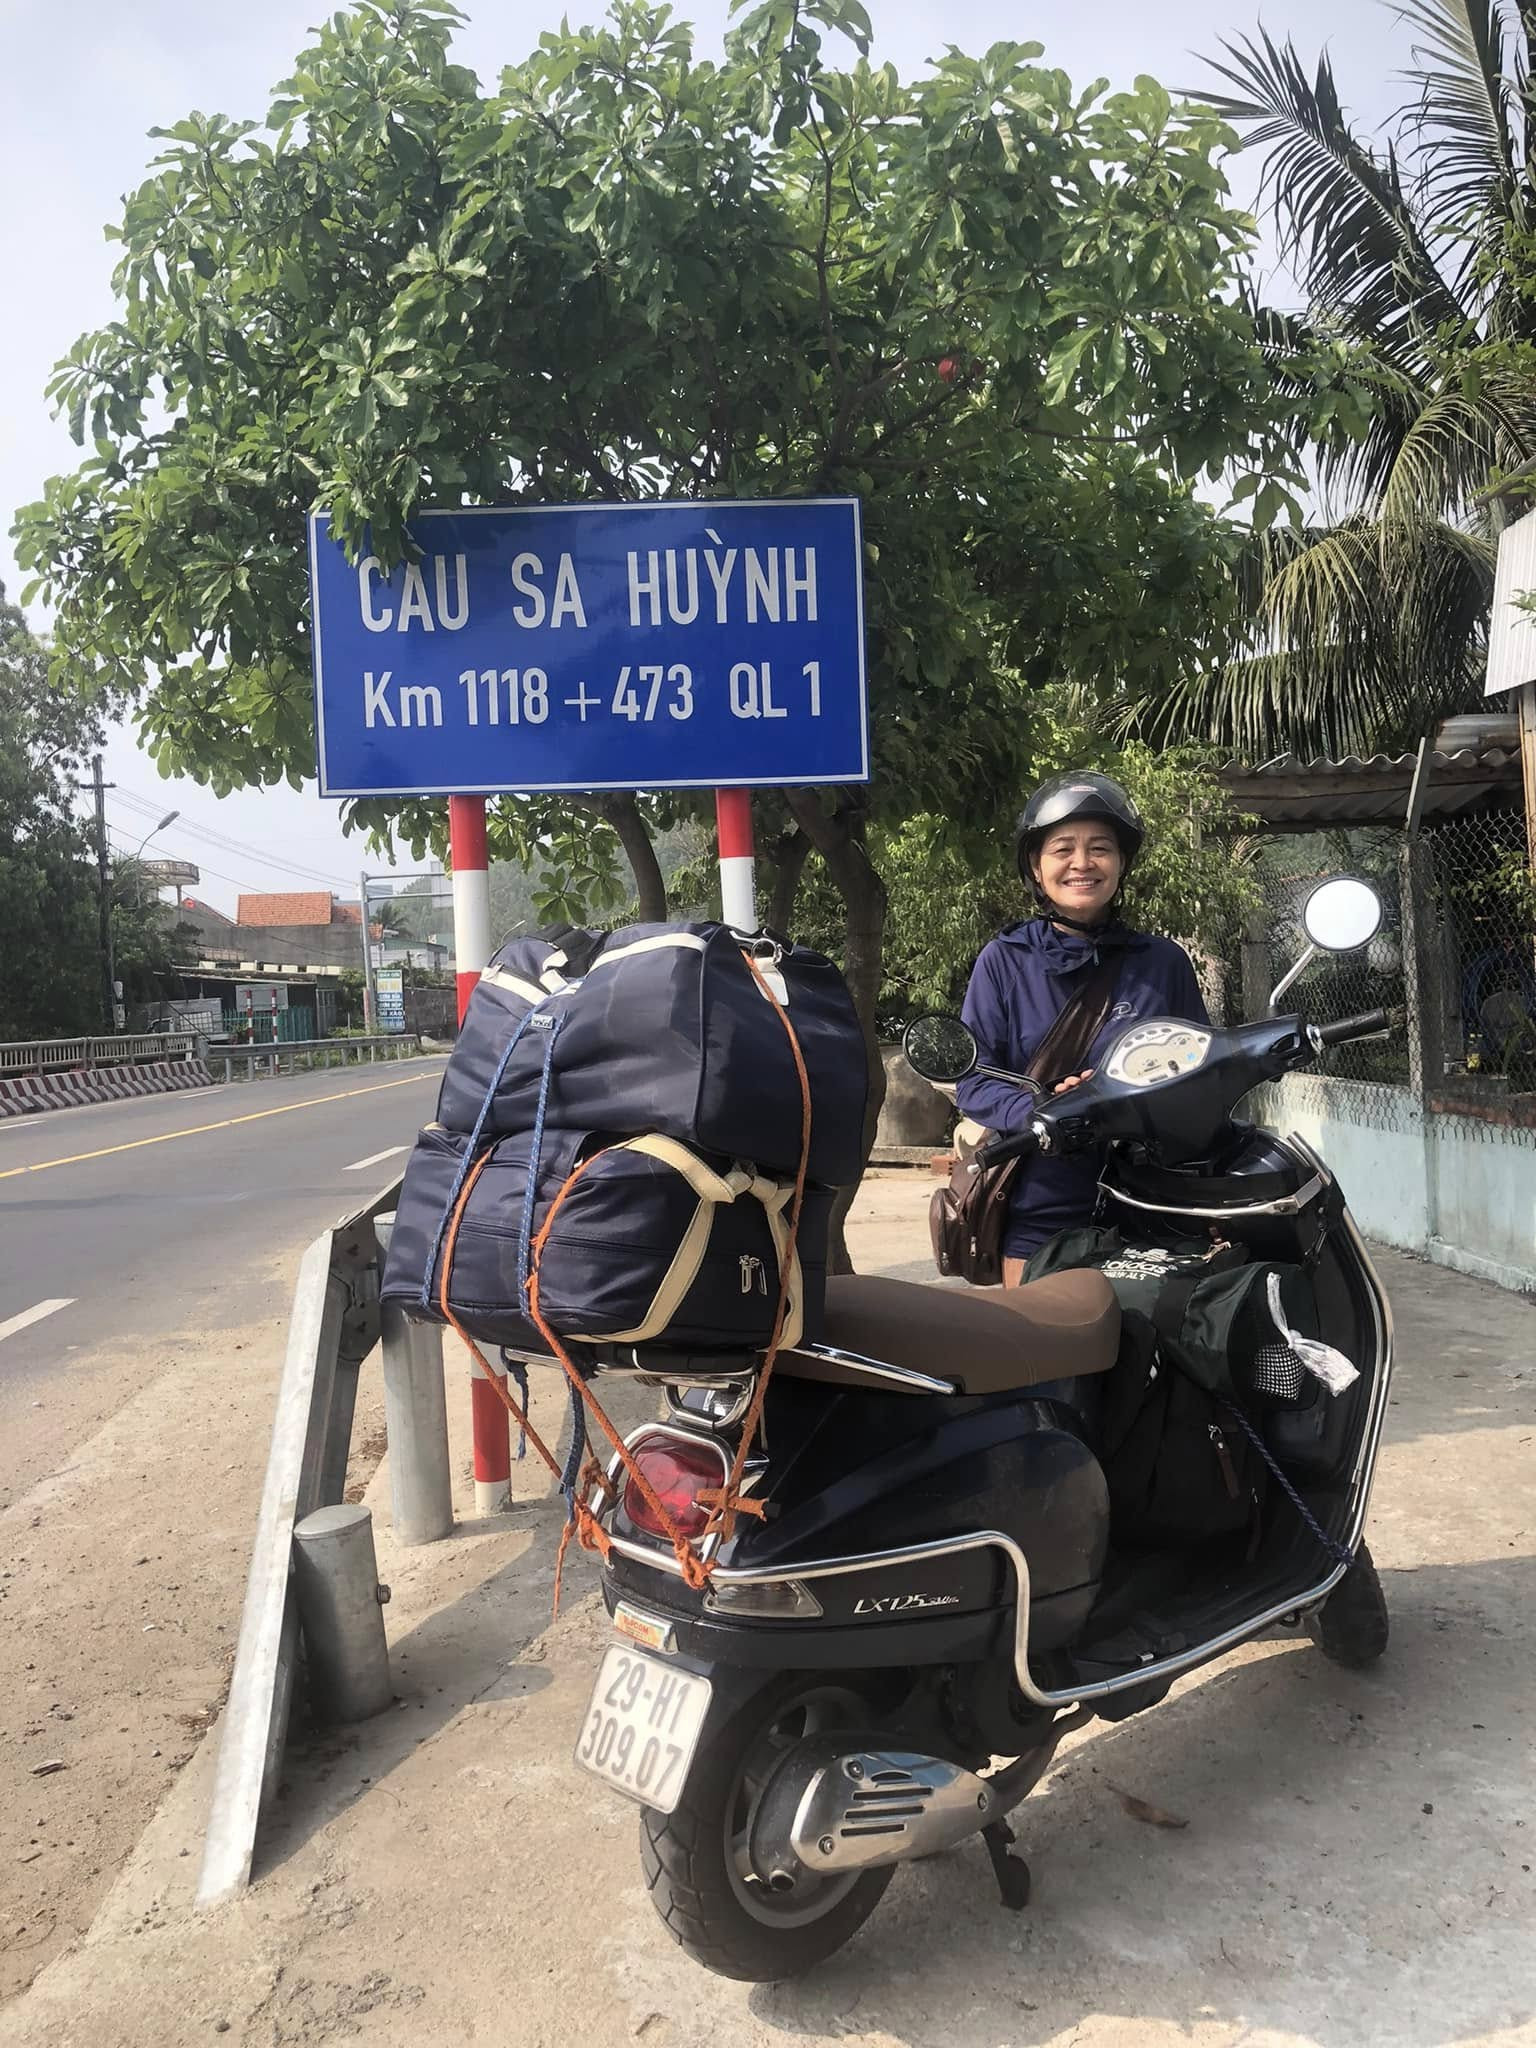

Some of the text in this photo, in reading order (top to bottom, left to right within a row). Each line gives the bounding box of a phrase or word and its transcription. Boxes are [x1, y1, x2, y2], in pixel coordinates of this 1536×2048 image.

[511, 552, 588, 629] SA
[627, 528, 818, 626] HUỲNH
[363, 671, 443, 728] Km
[459, 667, 549, 726] 1118
[611, 663, 694, 721] 473
[729, 662, 788, 719] QL
[802, 661, 821, 717] 1
[604, 1656, 692, 1735] 29-H1
[582, 1709, 684, 1797] 309.07
